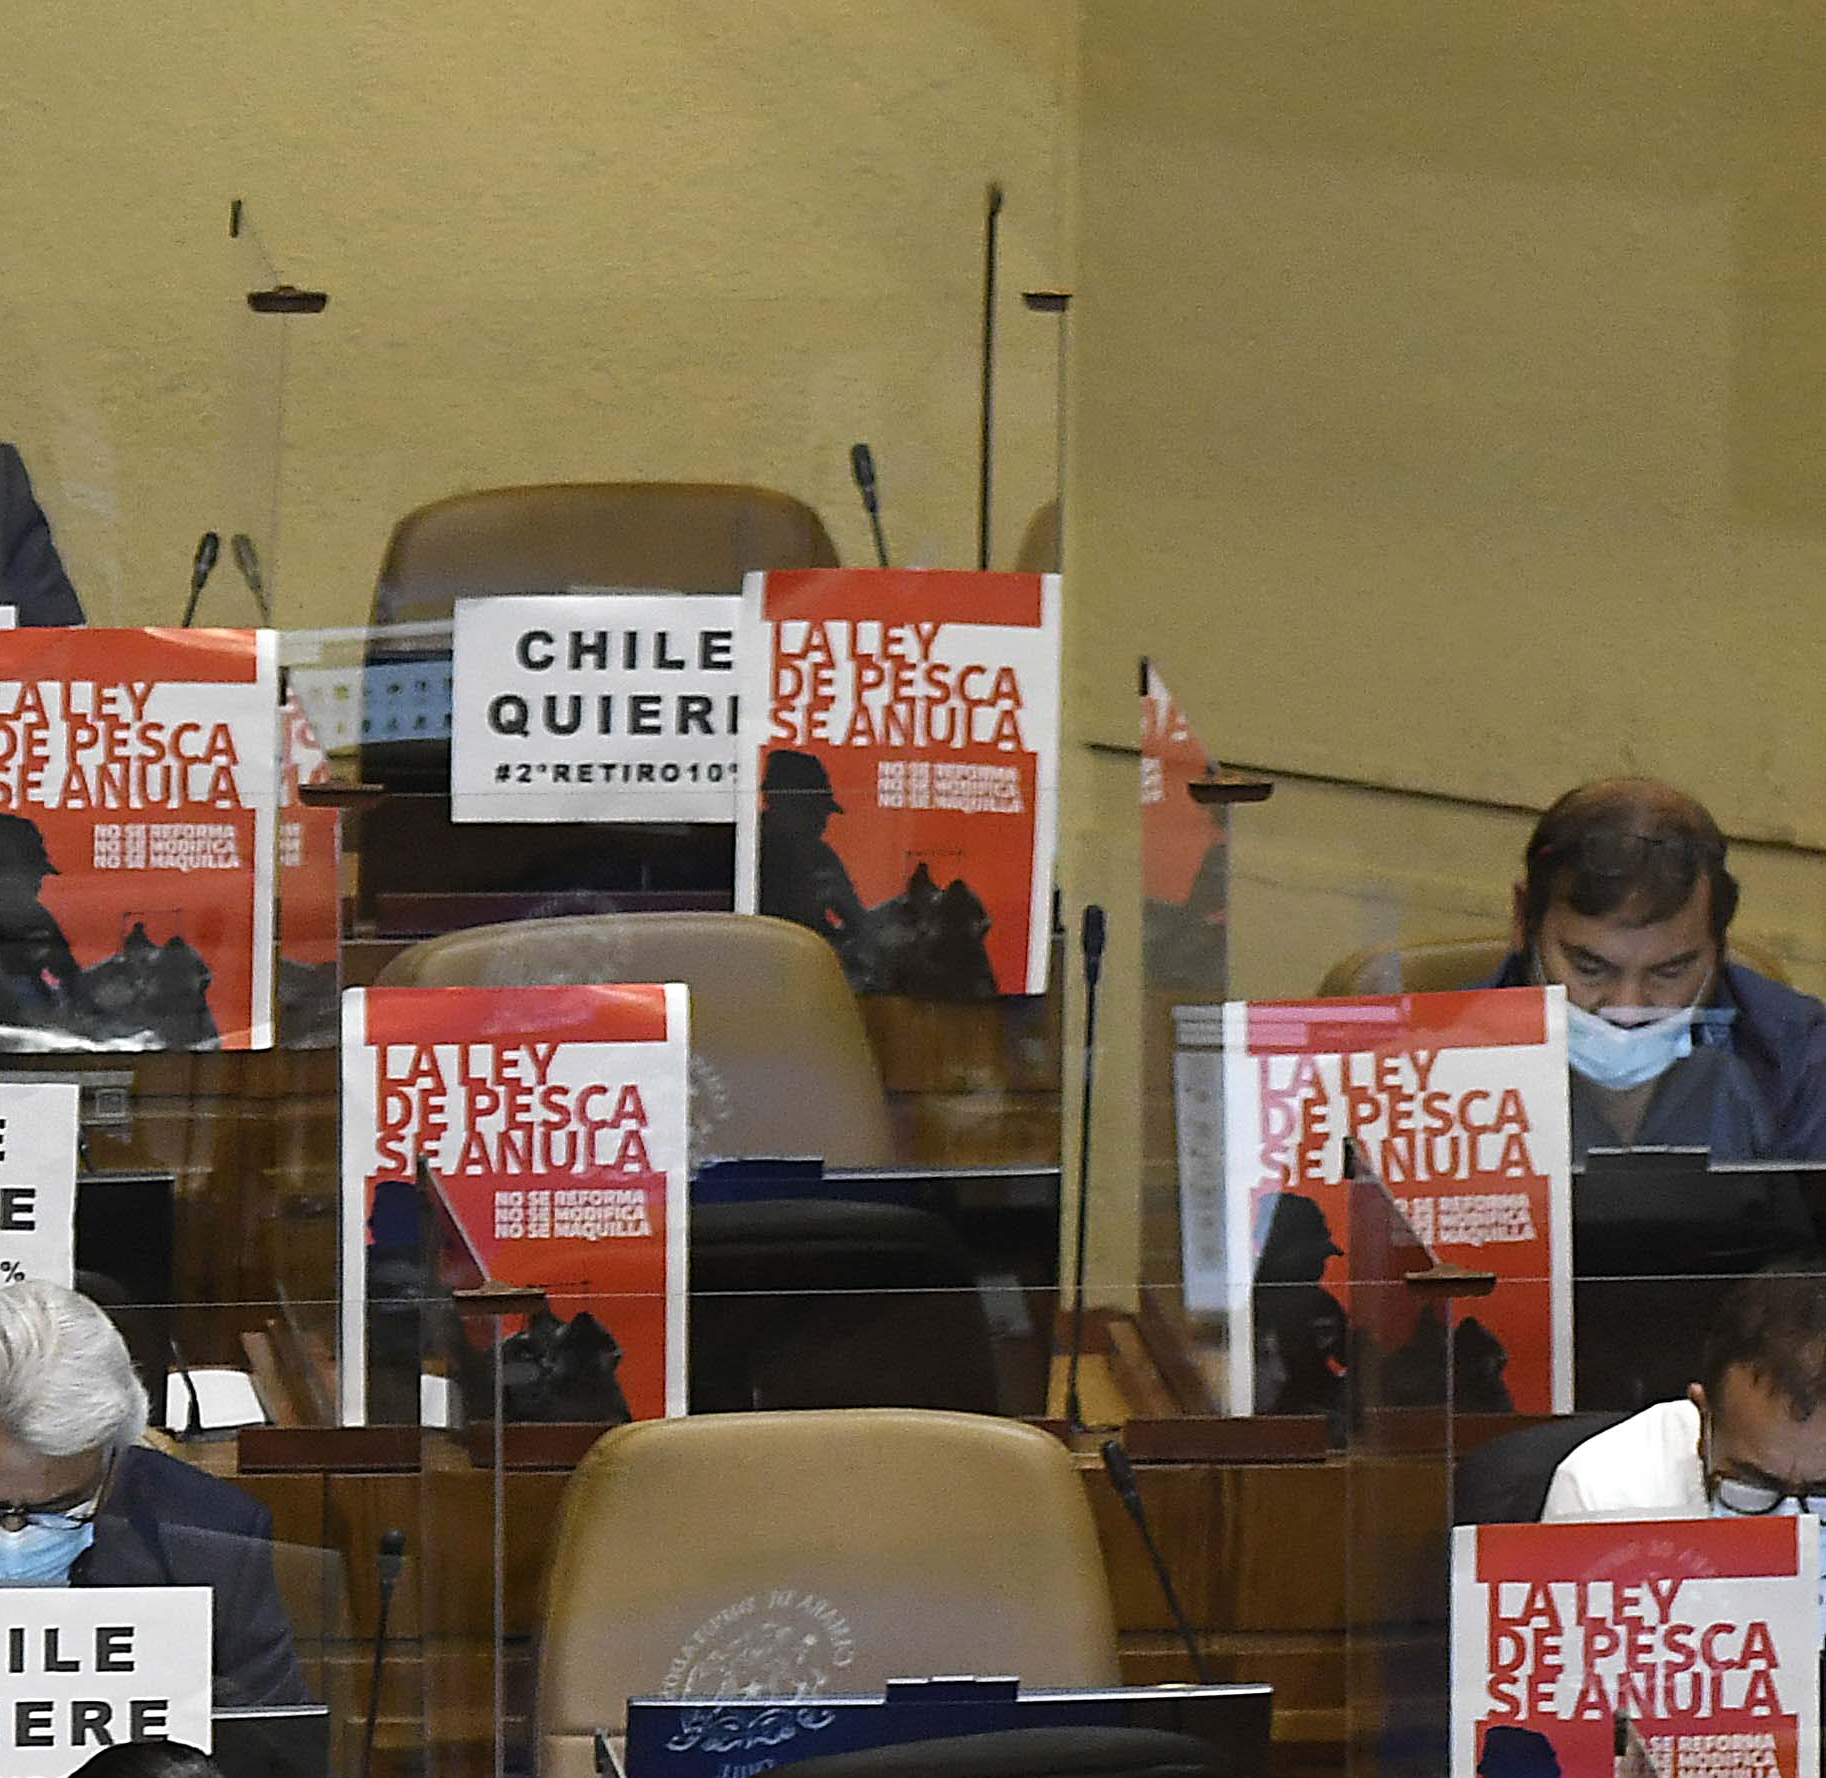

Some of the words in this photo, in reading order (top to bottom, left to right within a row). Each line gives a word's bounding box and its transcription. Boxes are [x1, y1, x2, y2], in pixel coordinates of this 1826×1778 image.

[518, 631, 732, 671] CHILE
[772, 621, 835, 664] LA
[851, 621, 943, 662] LEY
[61, 682, 155, 721] LEY
[772, 661, 836, 702] DE
[855, 662, 1023, 709] PESCA
[67, 722, 238, 764] PESCA
[770, 702, 831, 744] SE
[845, 704, 1025, 750] ANULA
[60, 764, 241, 808] ANULA
[496, 762, 738, 785] #2°RETIRO10
[375, 1042, 445, 1091] LA
[458, 1042, 559, 1086] LEY
[1259, 1054, 1327, 1099] LA
[1341, 1050, 1440, 1092] LEY
[376, 1085, 447, 1133] DE
[463, 1083, 647, 1130] PESCA
[1259, 1092, 1329, 1141] DE
[1349, 1088, 1530, 1136] PESCA
[375, 1133, 444, 1176] SE
[457, 1129, 652, 1175] ANULA
[1259, 1140, 1327, 1184] SE
[1488, 1581, 1562, 1629] LA
[1576, 1579, 1684, 1625] LEY
[1488, 1625, 1563, 1674] DE
[1583, 1621, 1780, 1672] PESCA
[1486, 1673, 1558, 1719] SE
[1574, 1668, 1783, 1719] ANULA
